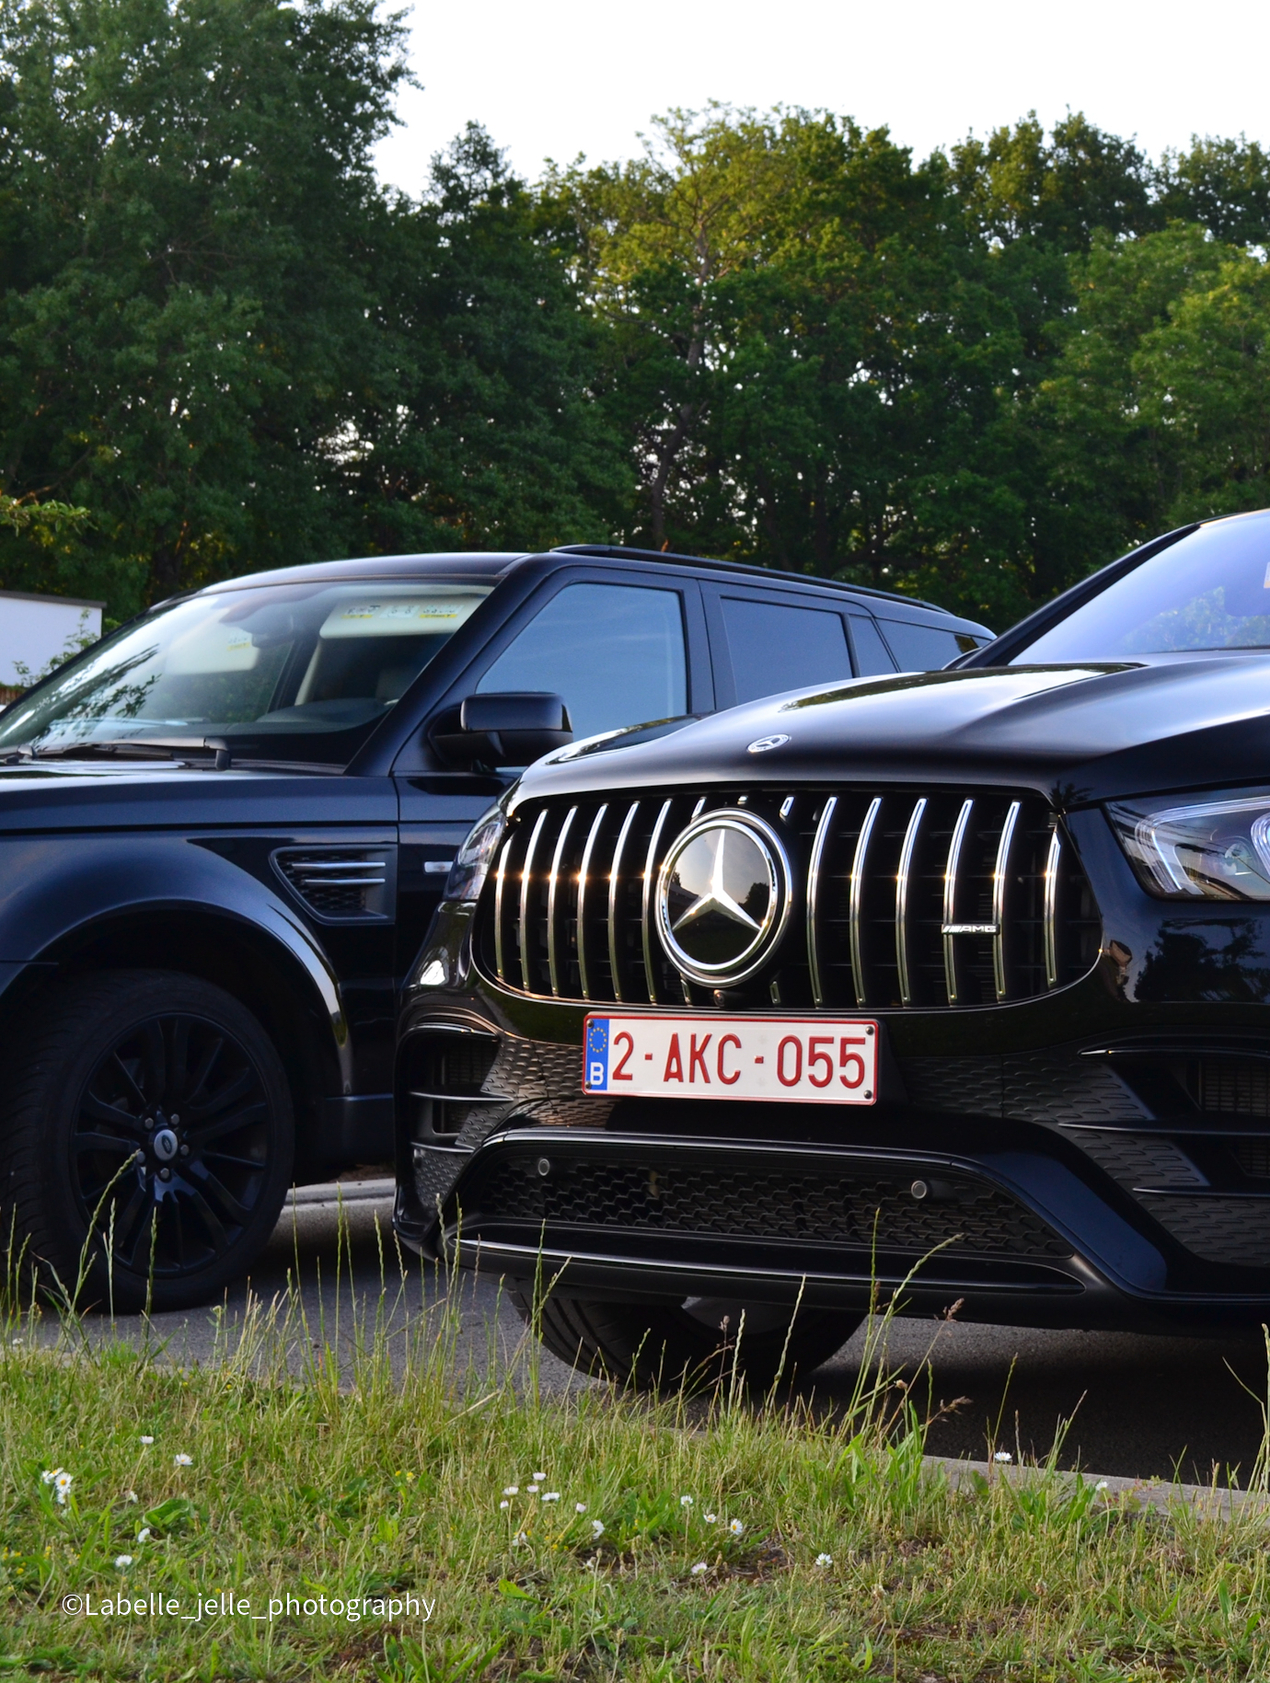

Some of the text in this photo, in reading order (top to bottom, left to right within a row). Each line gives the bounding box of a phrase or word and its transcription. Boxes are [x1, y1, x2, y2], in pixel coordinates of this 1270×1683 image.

[959, 925, 996, 933] AMG
[612, 1030, 866, 1089] 2-AKC-055
[590, 1062, 604, 1085] B
